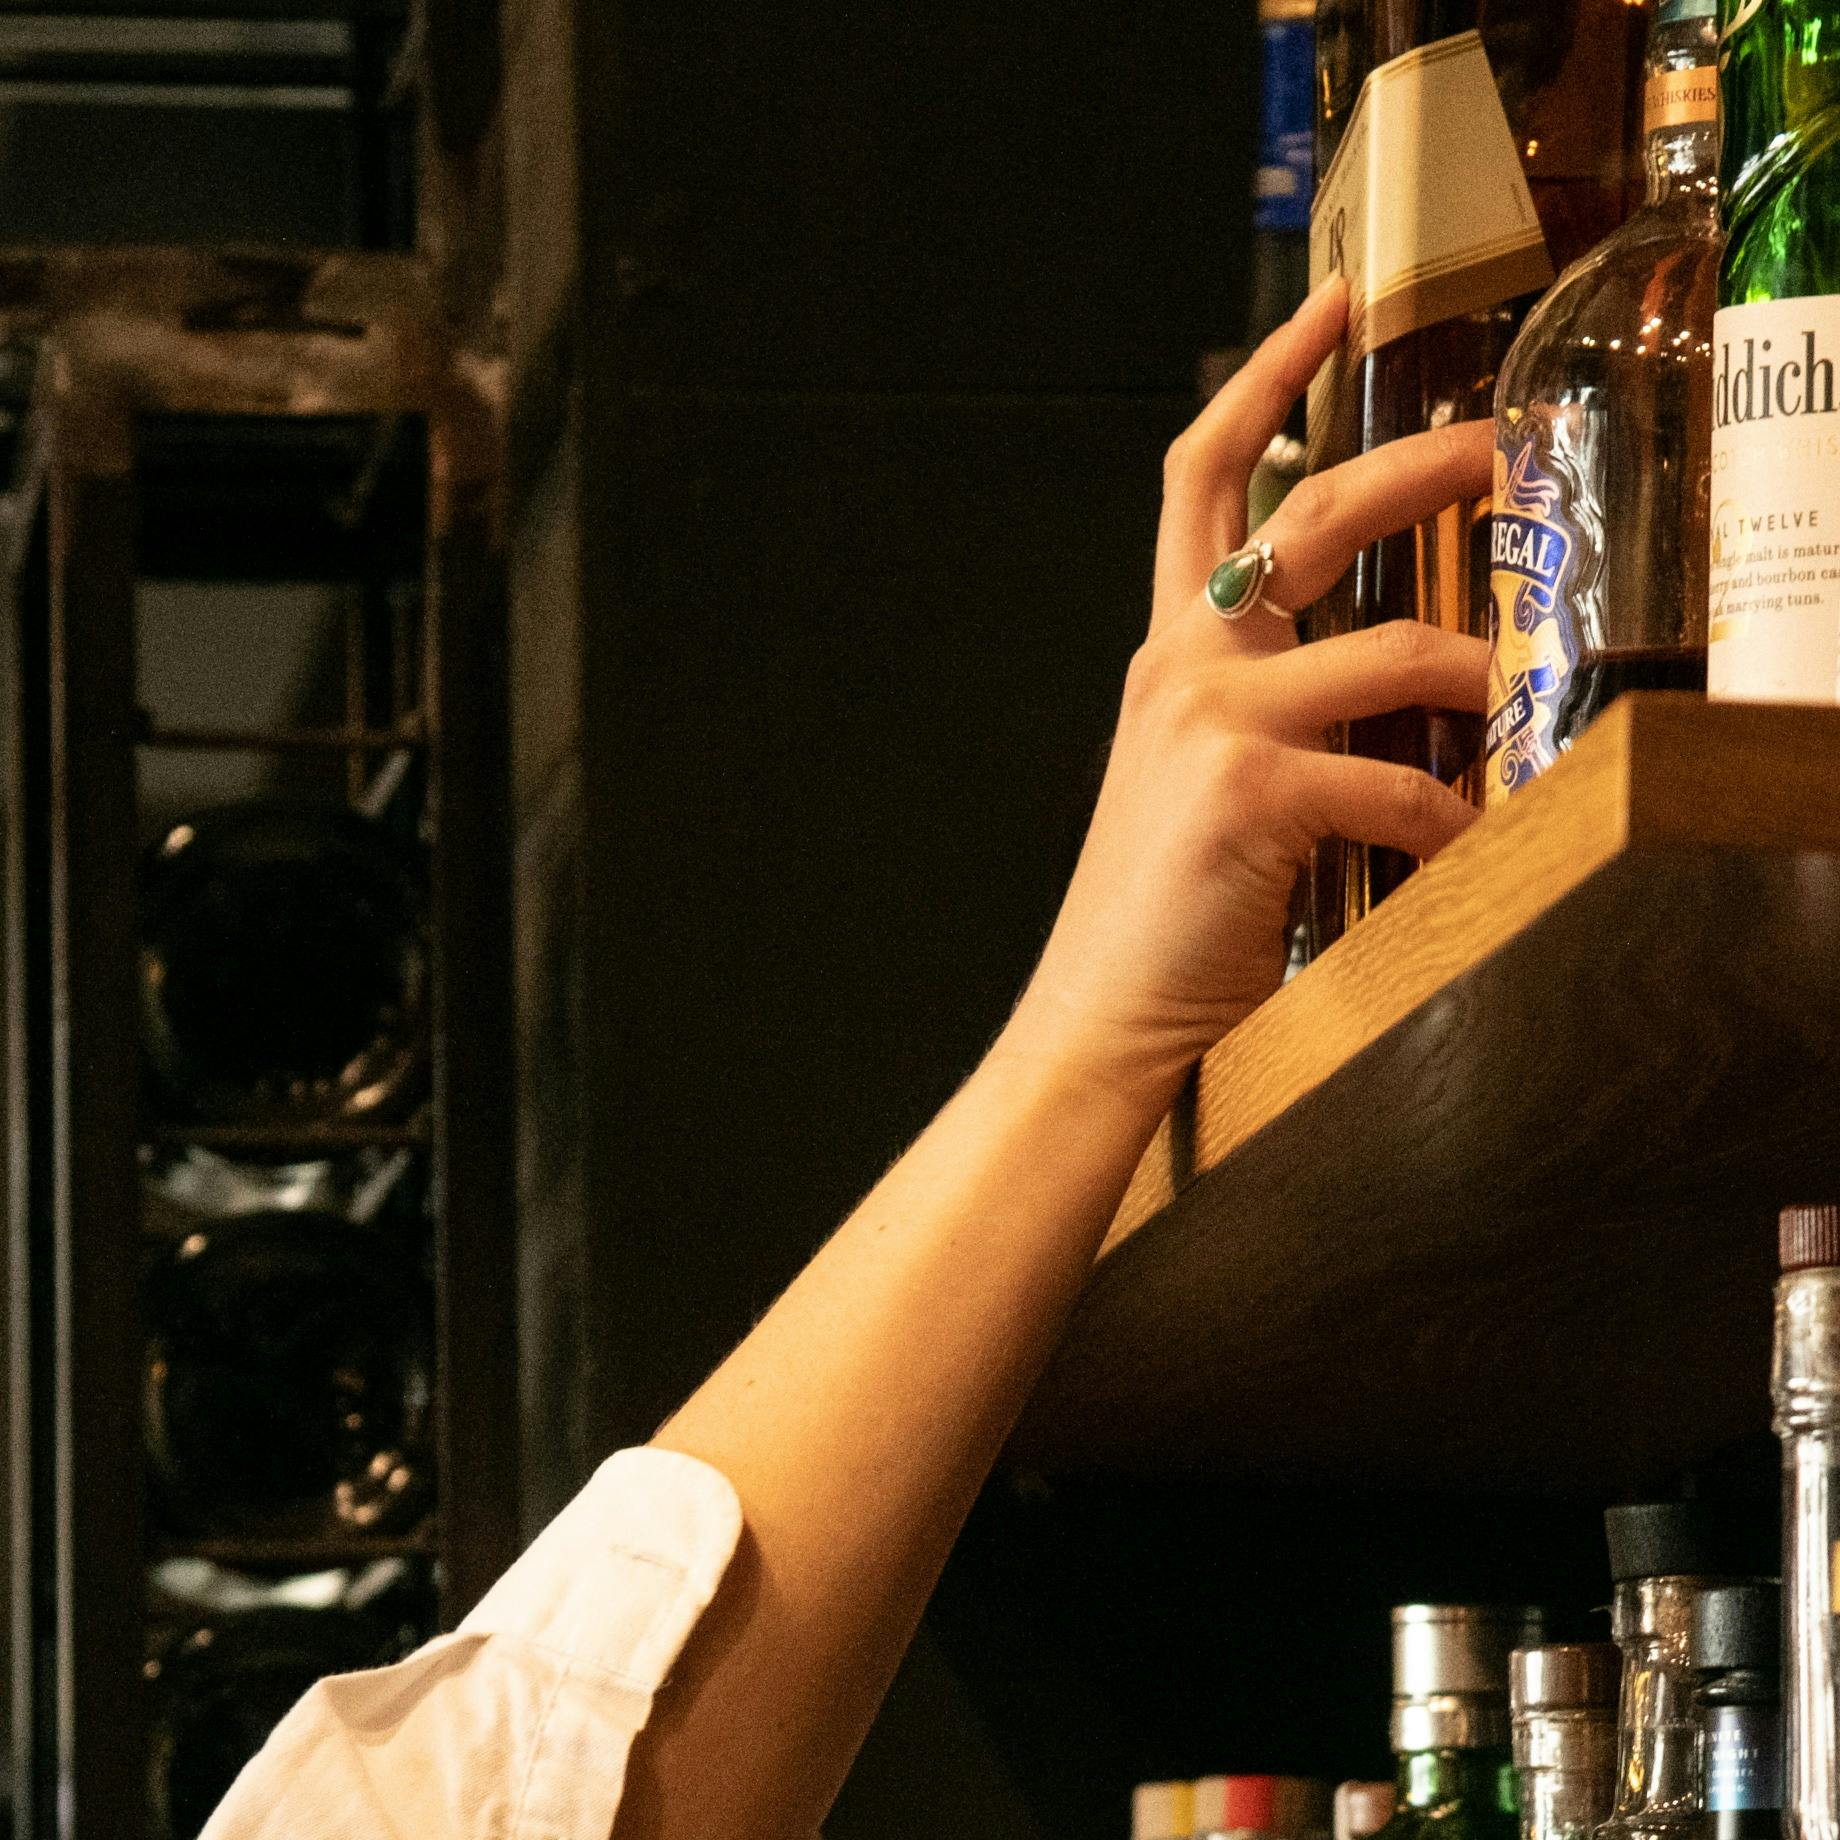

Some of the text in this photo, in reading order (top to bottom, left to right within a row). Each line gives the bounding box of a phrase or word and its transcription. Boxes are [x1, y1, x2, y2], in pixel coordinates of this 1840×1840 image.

[1712, 331, 1837, 430] ddich
[1738, 510, 1819, 535] TWELVE
[1745, 546, 1773, 563] malt
[1778, 546, 1789, 559] is
[1757, 567, 1816, 586] bourbon
[1788, 592, 1825, 607] tuns.
